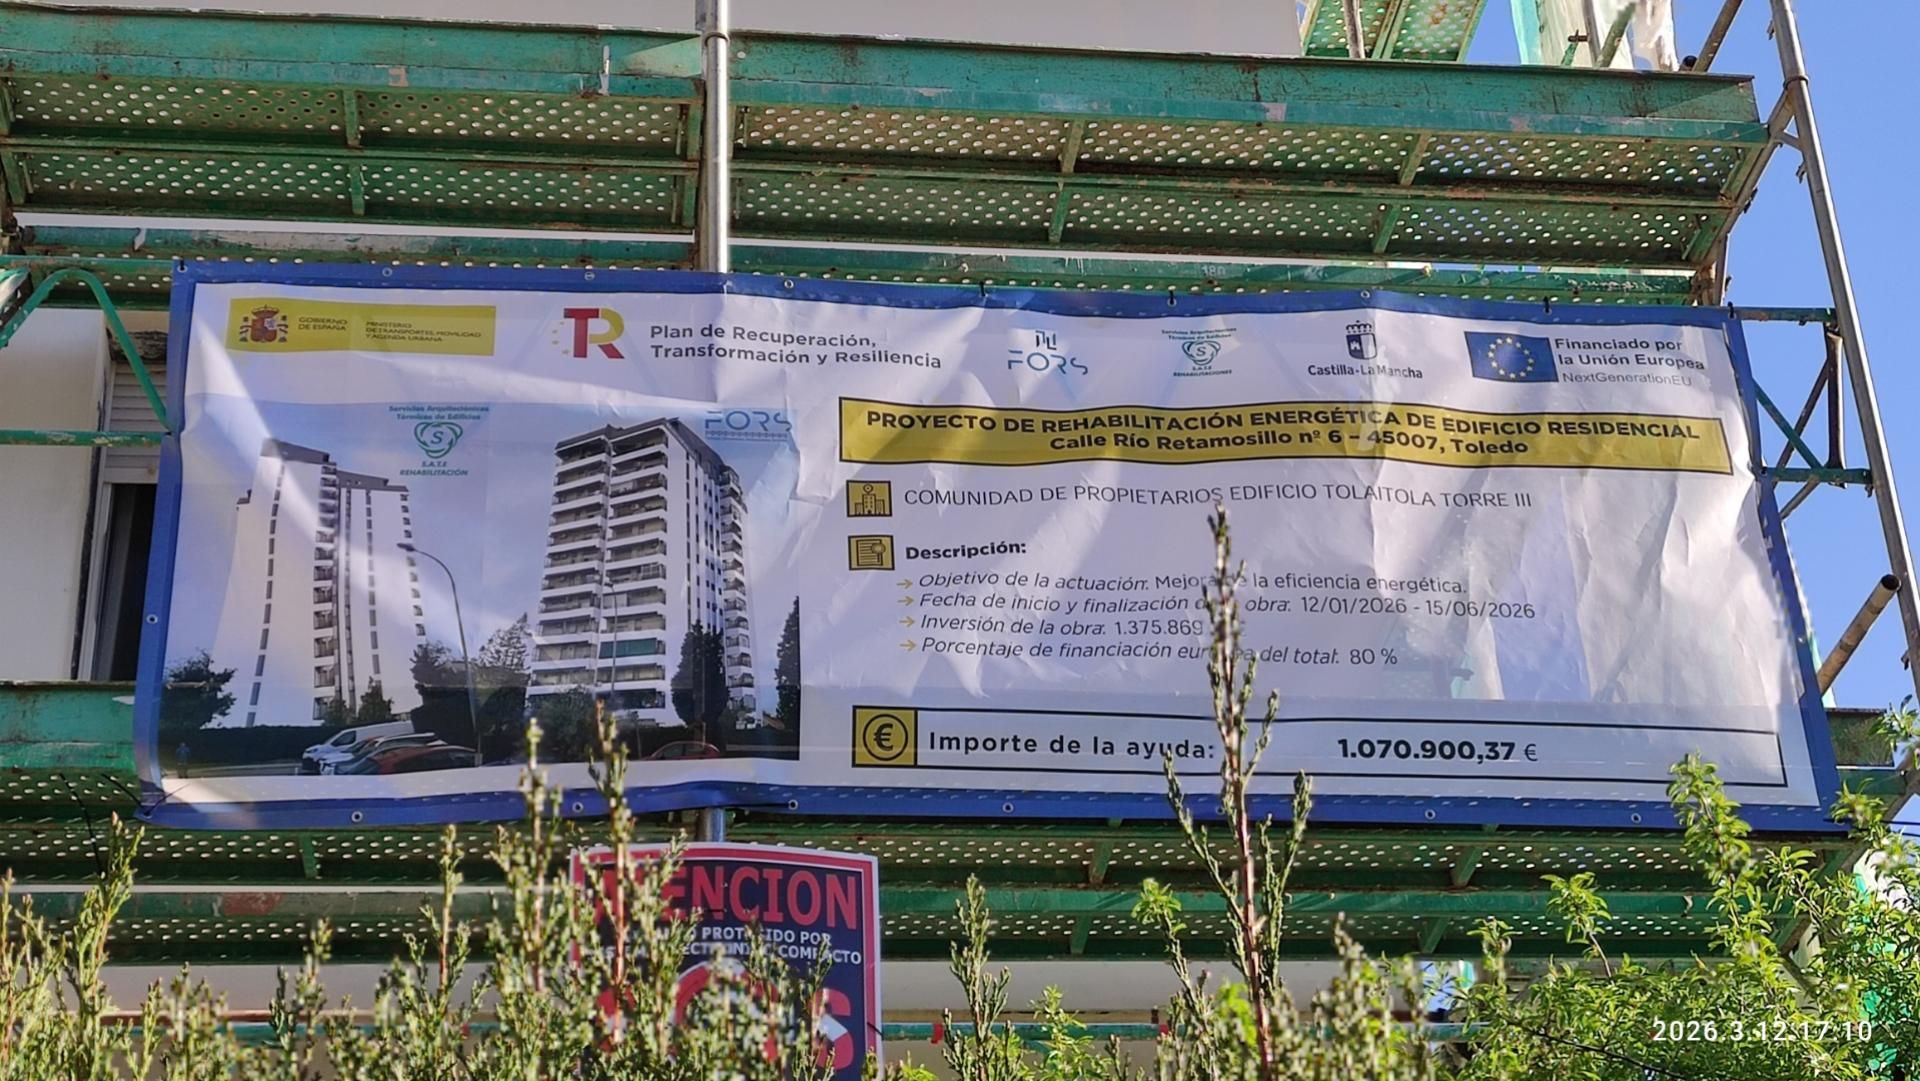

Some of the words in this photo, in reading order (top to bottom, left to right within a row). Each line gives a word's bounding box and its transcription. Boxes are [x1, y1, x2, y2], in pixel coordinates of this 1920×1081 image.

[298, 316, 347, 325] GOBIERNO
[650, 324, 693, 339] Plan
[700, 323, 725, 338] de
[732, 326, 876, 348] Recuperación,
[1555, 338, 1650, 350] Financiado
[1655, 340, 1683, 352] por
[650, 343, 810, 364] Transformación
[816, 353, 828, 366] y
[835, 350, 942, 369] Resiliencia
[1558, 354, 1574, 366] la
[1578, 354, 1630, 366] Unión
[1634, 354, 1705, 370] Europea
[1307, 364, 1375, 376] Castilla-La
[1376, 365, 1424, 379] Mancha
[1562, 373, 1692, 387] NextGenerationEU
[704, 410, 793, 432] FORS
[867, 410, 997, 431] PROYECTO
[1003, 417, 1035, 433] DE
[1041, 412, 1243, 433] REHABILITACIÓN
[1250, 406, 1400, 426] ENERGÉTICA
[1406, 412, 1436, 429] DE
[1443, 417, 1541, 435] EDIFICIO
[1547, 422, 1701, 439] RESIDENCIAL
[1050, 434, 1107, 450] Calle
[1113, 432, 1150, 449] Río
[1156, 431, 1292, 450] Retamosillo
[1328, 430, 1343, 444] 6
[1367, 430, 1445, 454] 45007,
[1450, 438, 1529, 454] Toledo
[904, 489, 1033, 505] COMUNIDAD
[1040, 487, 1067, 501] DE
[1074, 486, 1222, 505] PROPIETARIOS
[1230, 484, 1317, 500] EDIFICIO
[1323, 484, 1436, 507] TOLAITOLA
[1443, 492, 1509, 507] TORRE
[1514, 493, 1532, 507] III
[905, 541, 1027, 561] Descripción:
[919, 571, 999, 588] Objetivo
[1005, 572, 1029, 587] de
[1034, 573, 1050, 588] la
[1253, 572, 1269, 588] la
[1274, 572, 1361, 590] eficiencia
[1366, 576, 1467, 594] energética.
[920, 593, 977, 607] Fecha
[982, 594, 1006, 609] de
[1011, 595, 1060, 612] inicio
[1065, 601, 1078, 615] y
[1083, 596, 1189, 613] finalización
[1245, 597, 1292, 612] obra:
[1302, 596, 1408, 614] 12/01/2026
[1426, 600, 1536, 619] 15/06/2026
[921, 615, 1005, 633] Inversión
[1010, 618, 1034, 634] de
[1039, 620, 1055, 635] la
[1060, 621, 1107, 636] obra:
[922, 637, 1024, 659] Porcentaje
[1029, 642, 1054, 657] de
[1059, 642, 1172, 658] financiación
[1260, 646, 1288, 663] del
[1293, 648, 1341, 664] total:
[1350, 648, 1376, 665] 80
[1380, 648, 1398, 665] %
[929, 732, 1038, 754] Importe
[1049, 735, 1081, 753] de
[1093, 736, 1114, 754] la
[1126, 739, 1215, 759] ayuda:
[1338, 739, 1515, 764] 1.070.900,37
[1524, 743, 1538, 762] €
[594, 865, 858, 930] AENCION
[702, 926, 796, 943] PROTIDO
